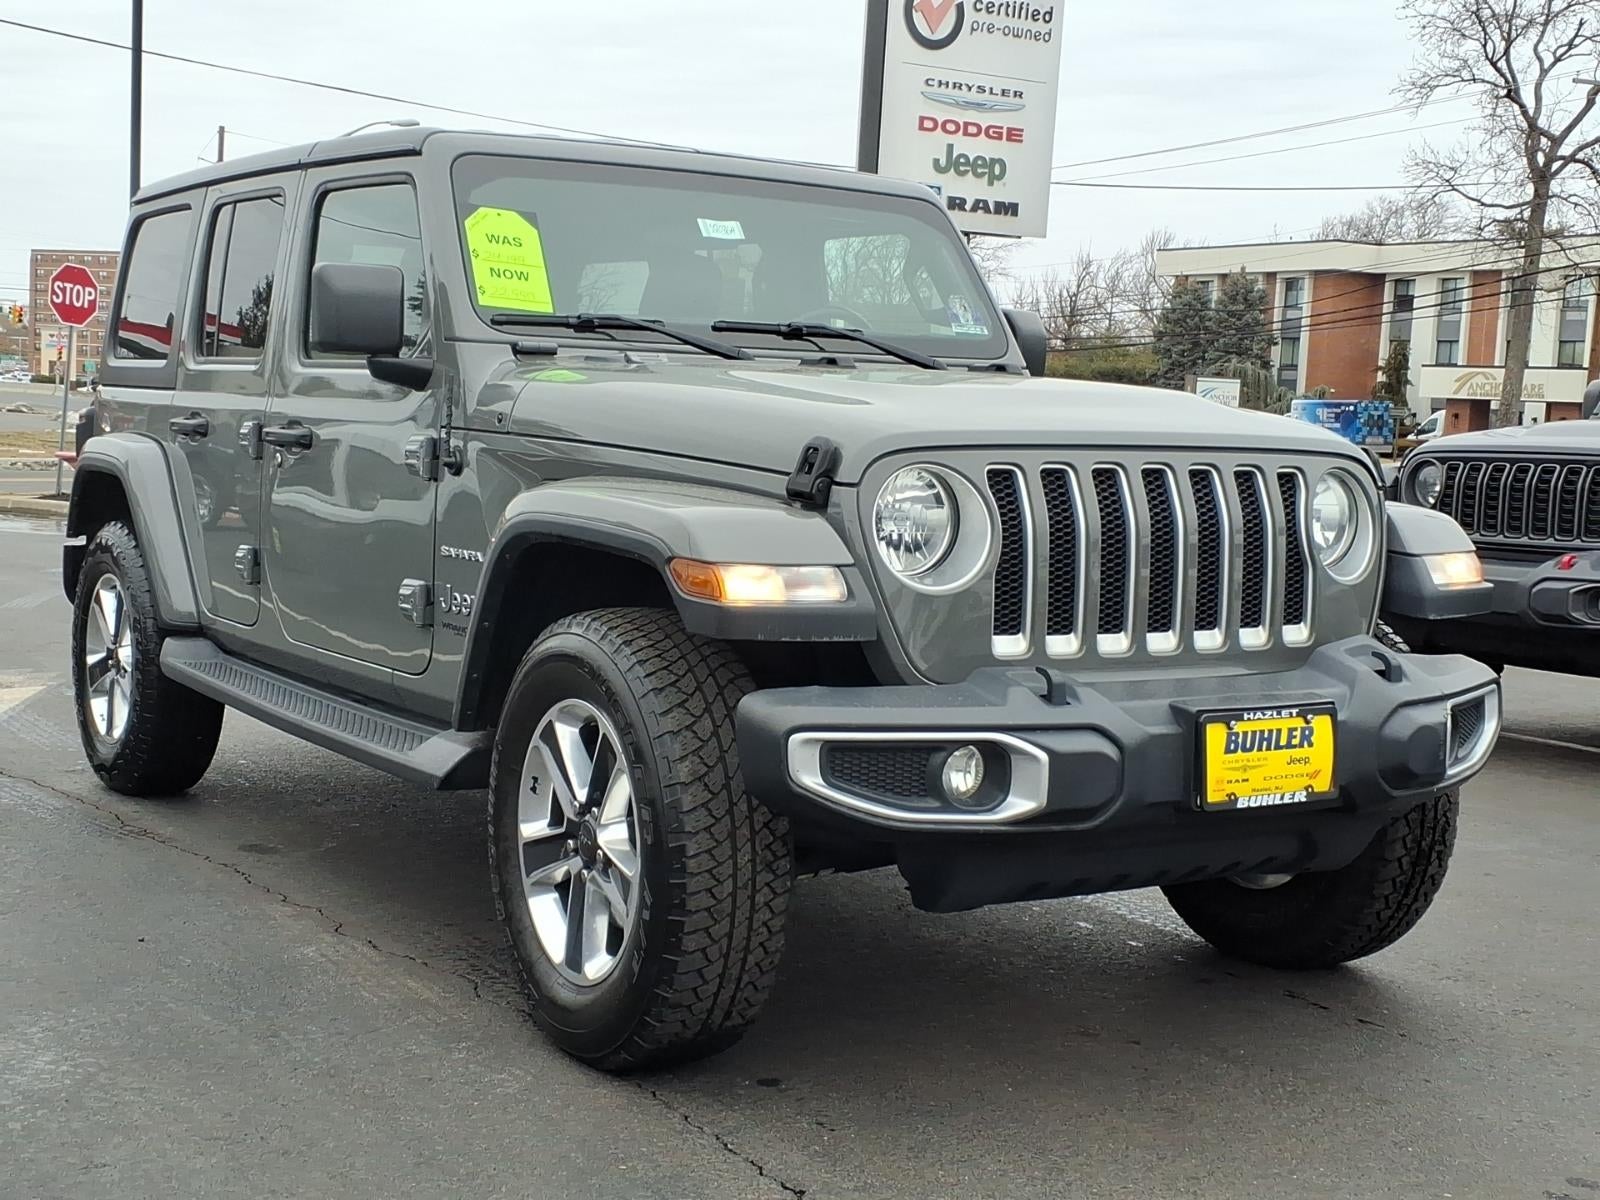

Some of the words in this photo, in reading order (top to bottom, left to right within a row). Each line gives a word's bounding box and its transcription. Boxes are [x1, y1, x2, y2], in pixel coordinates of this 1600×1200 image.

[973, 0, 1054, 24] certified
[970, 20, 1052, 43] pre-owned
[924, 77, 1024, 100] CHRYSLER
[918, 115, 1025, 143] DODGE
[932, 143, 1007, 187] Jeep
[947, 195, 1020, 218] RAM
[485, 233, 523, 248] WAS
[489, 266, 530, 282] NOW
[52, 280, 96, 309] STOP
[440, 583, 476, 616] Jee
[1243, 708, 1300, 721] HAZLET
[1223, 725, 1315, 755] BUHLER
[1222, 756, 1269, 766] CHRYSLER
[1286, 755, 1311, 767] Jeep
[1226, 777, 1250, 785] RAM
[1263, 772, 1313, 782] DODGE
[1237, 791, 1307, 808] BUHLER
